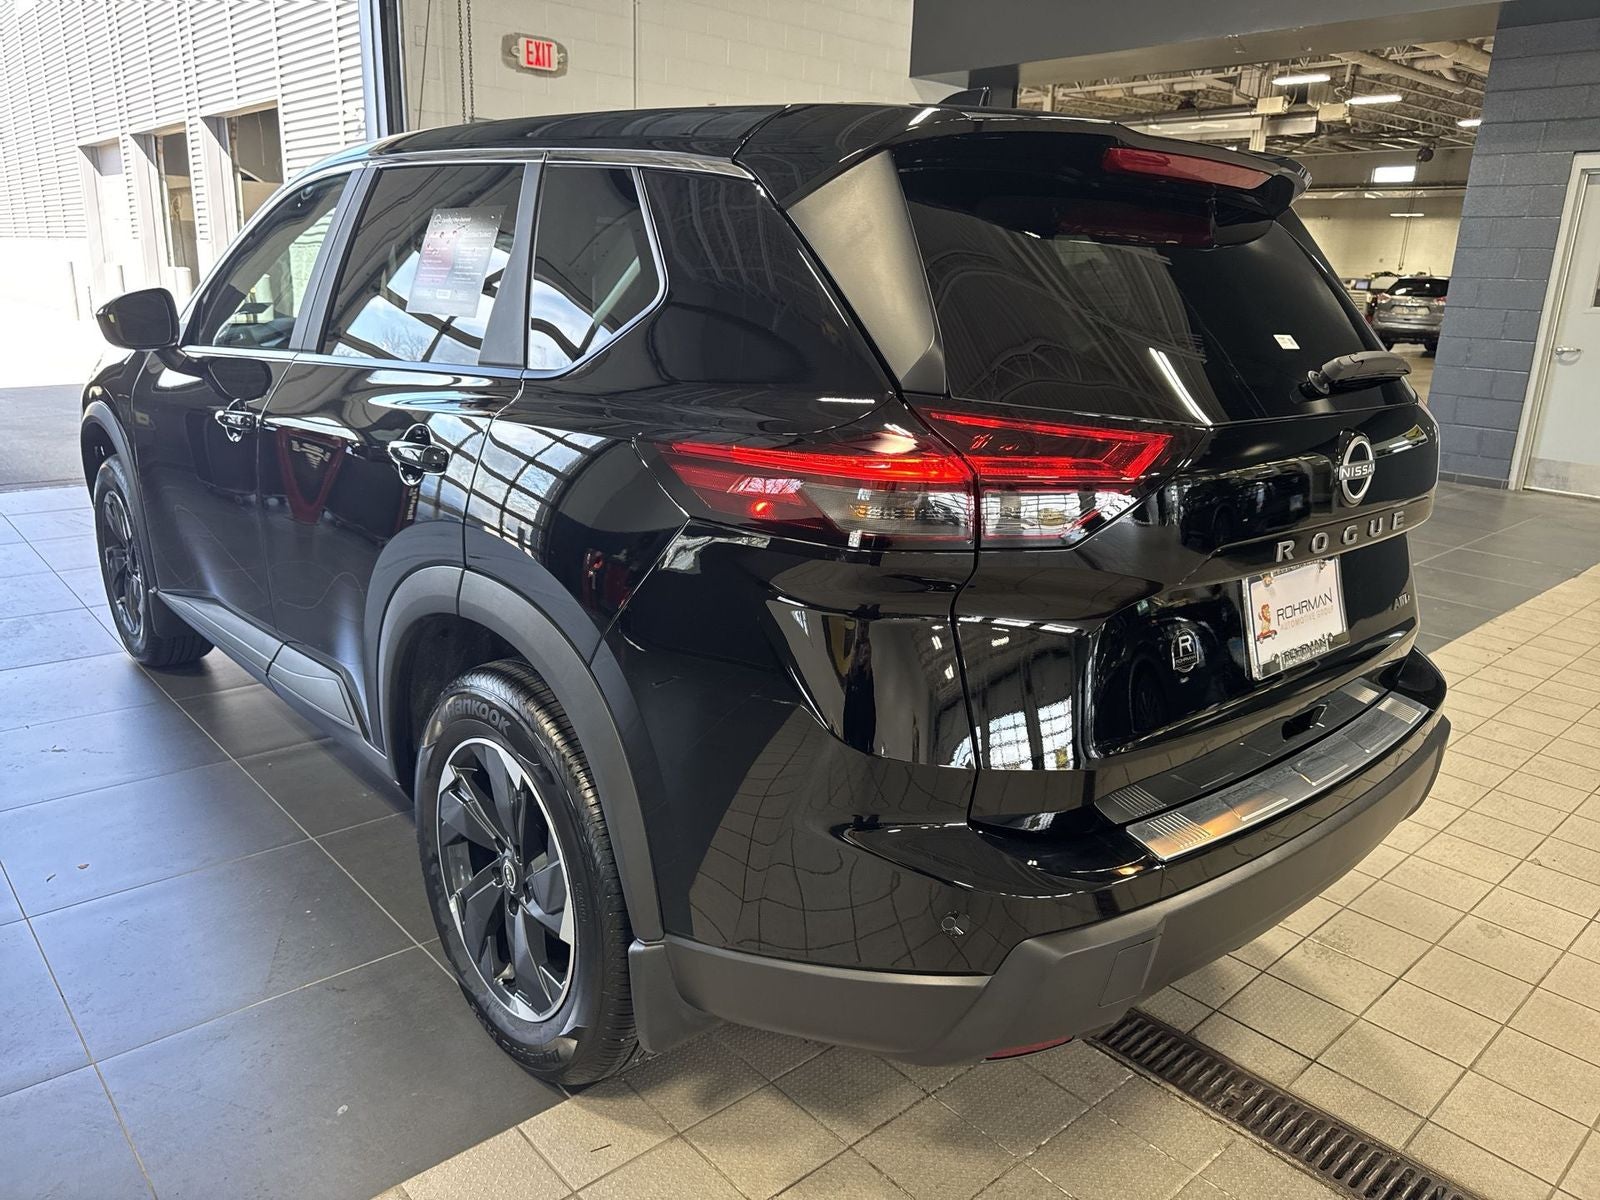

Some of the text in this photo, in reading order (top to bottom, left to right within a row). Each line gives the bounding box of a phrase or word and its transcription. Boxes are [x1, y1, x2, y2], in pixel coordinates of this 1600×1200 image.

[526, 40, 553, 68] EXIT
[1275, 511, 1405, 563] ROGUE
[1277, 587, 1333, 626] ROHRMAN
[1178, 634, 1193, 657] R
